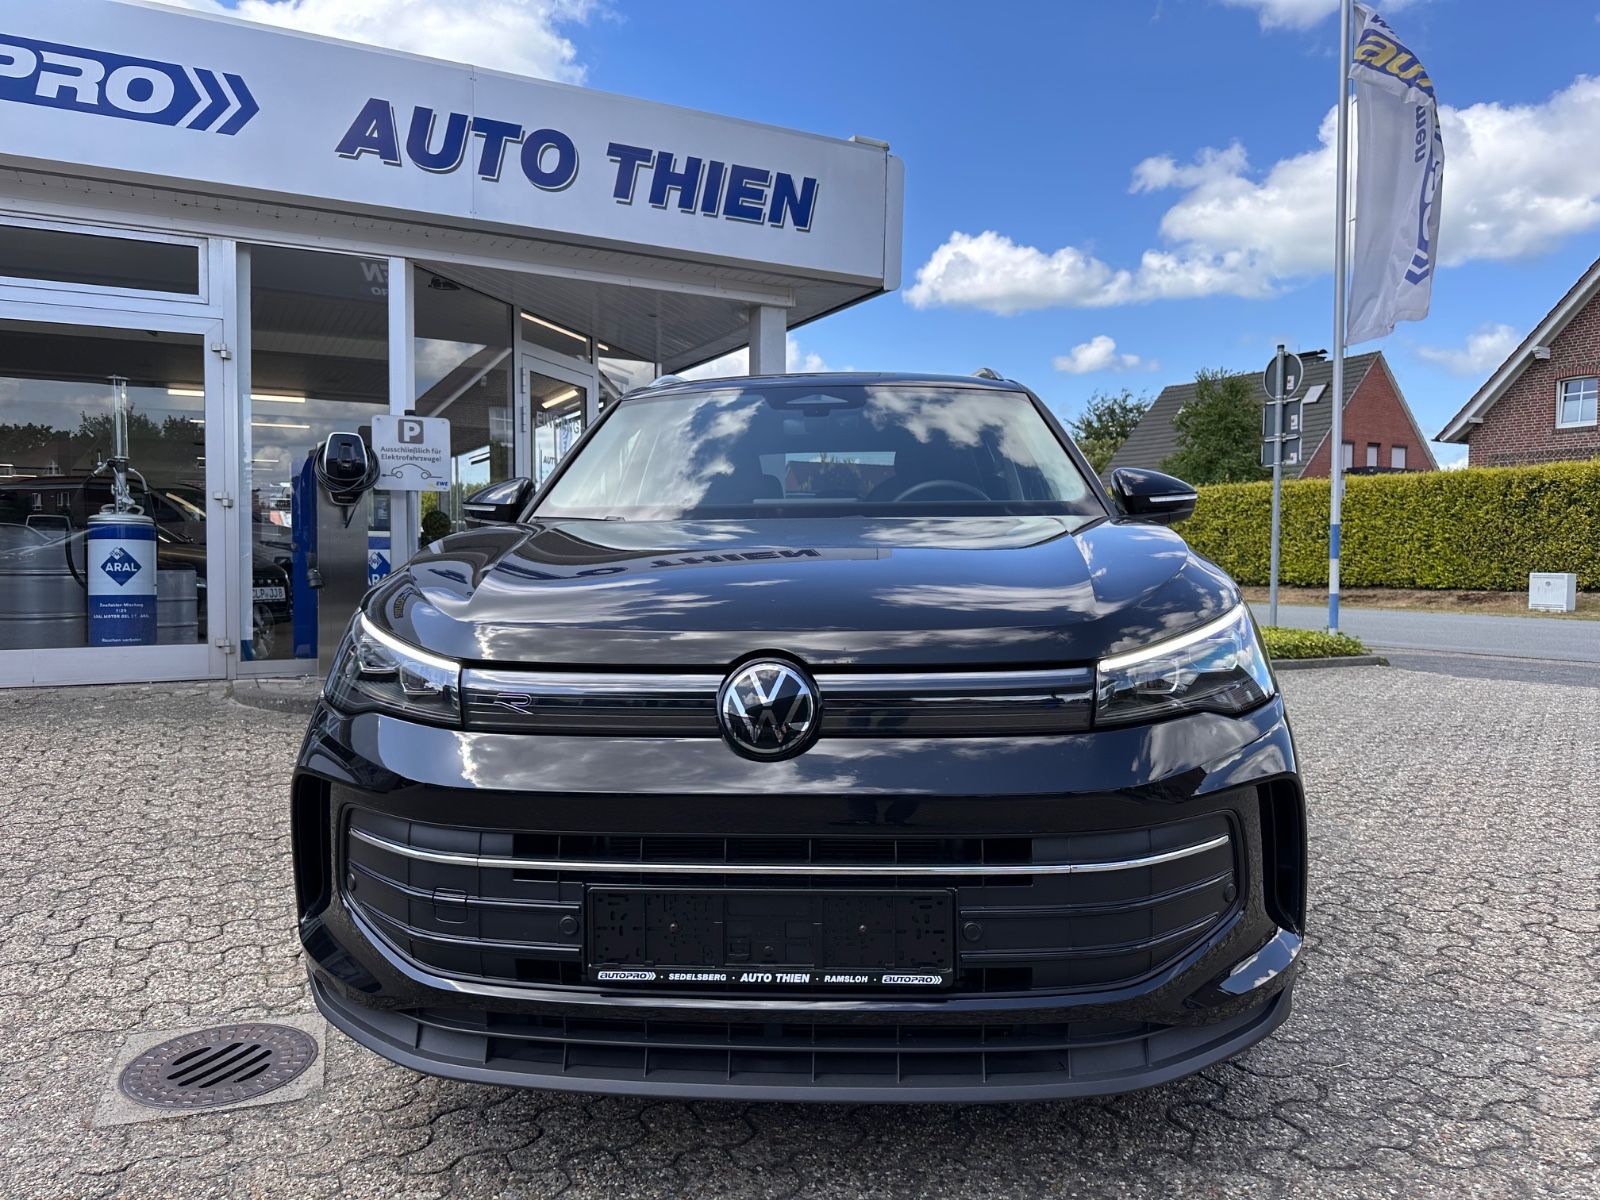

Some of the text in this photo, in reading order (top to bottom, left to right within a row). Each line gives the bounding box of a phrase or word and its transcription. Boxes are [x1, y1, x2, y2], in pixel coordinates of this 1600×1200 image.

[335, 97, 819, 232] AUTO THIEN
[403, 421, 421, 442] P
[380, 446, 430, 455] Ausschließlich
[105, 562, 138, 572] ARAL
[668, 973, 727, 981] SEDELSBERG
[740, 973, 772, 982] AUTO
[775, 974, 810, 983] THIEN
[824, 975, 868, 983] RAMSLOH
